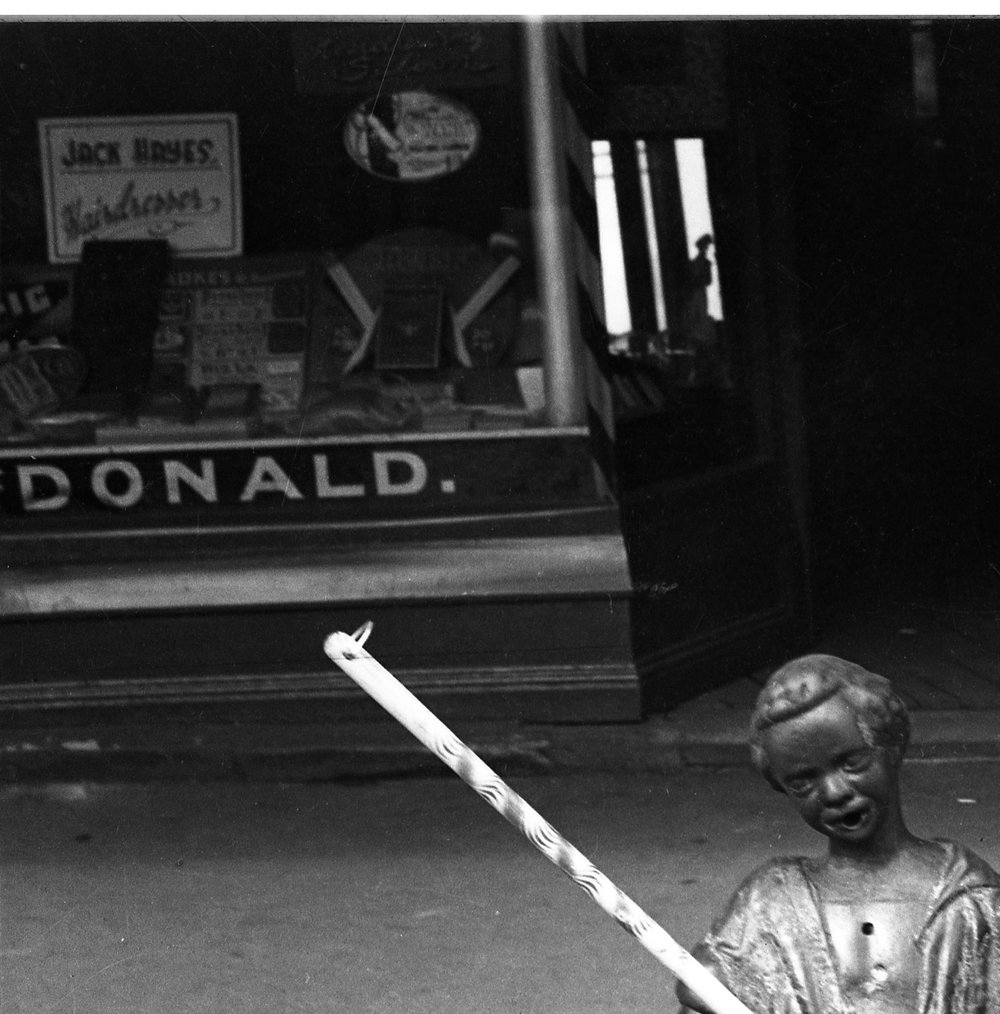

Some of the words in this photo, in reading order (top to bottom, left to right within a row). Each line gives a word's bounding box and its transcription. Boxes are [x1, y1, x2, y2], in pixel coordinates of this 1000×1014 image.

[62, 140, 121, 167] JACK
[62, 180, 204, 243] Hairdresser
[0, 450, 457, 511] DONALD.
